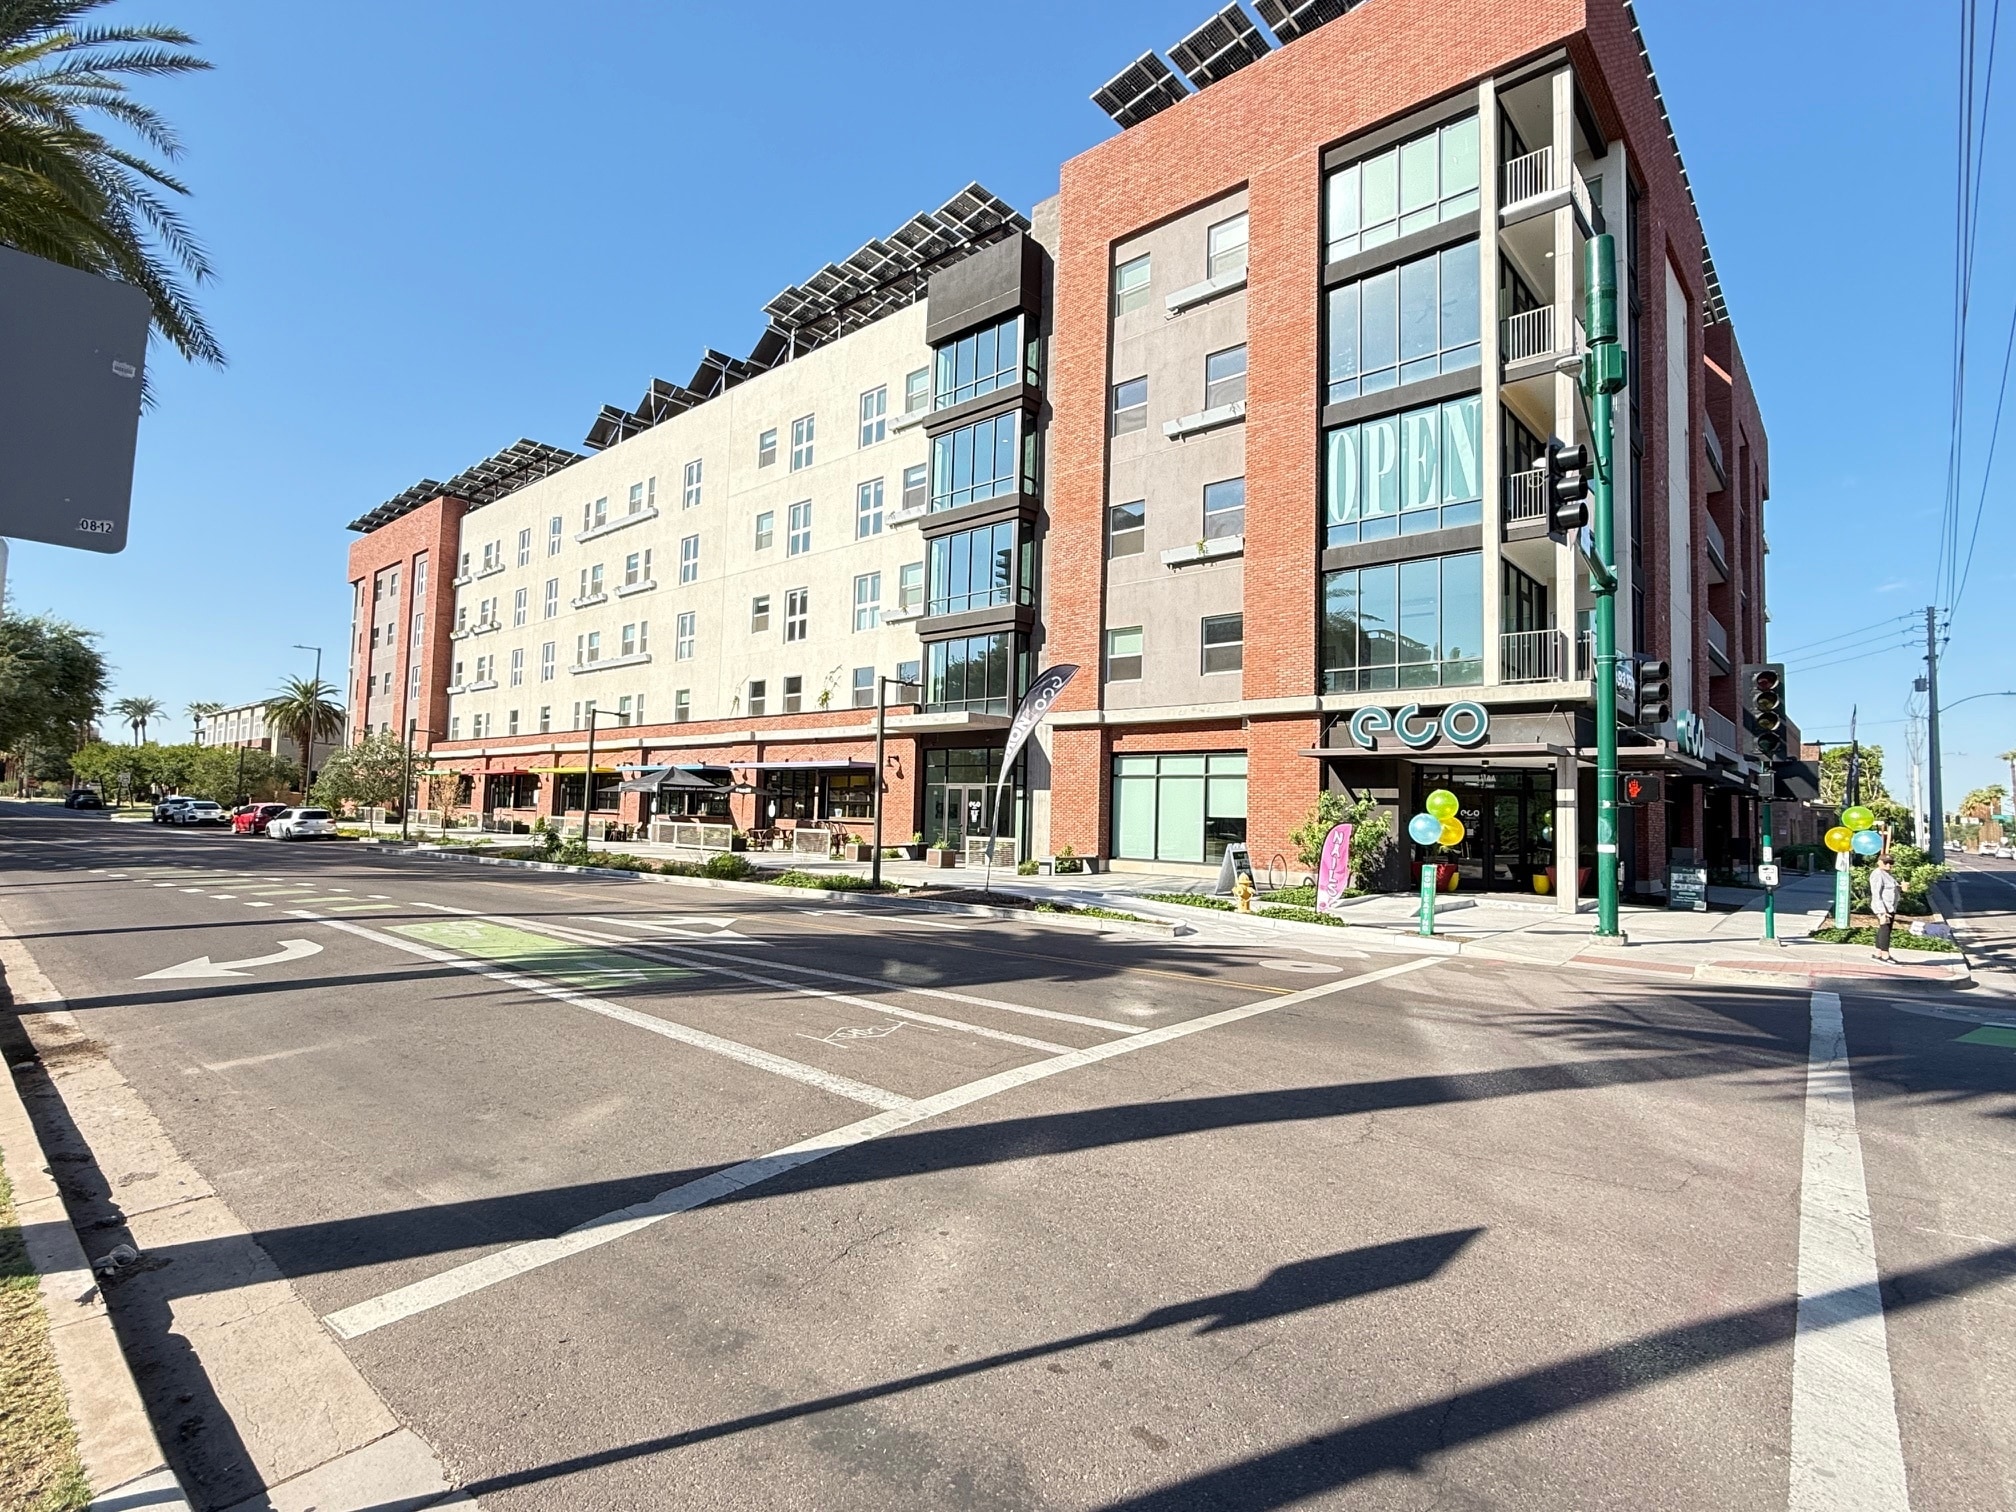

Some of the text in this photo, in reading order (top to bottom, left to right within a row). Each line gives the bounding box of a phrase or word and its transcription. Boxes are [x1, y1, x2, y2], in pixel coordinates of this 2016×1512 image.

[1328, 400, 1481, 522] OPEN
[81, 519, 112, 533] 08-12
[1034, 675, 1063, 711] eco
[1350, 700, 1488, 747] eco
[1460, 809, 1480, 817] eco
[1326, 830, 1344, 897] NAILS
